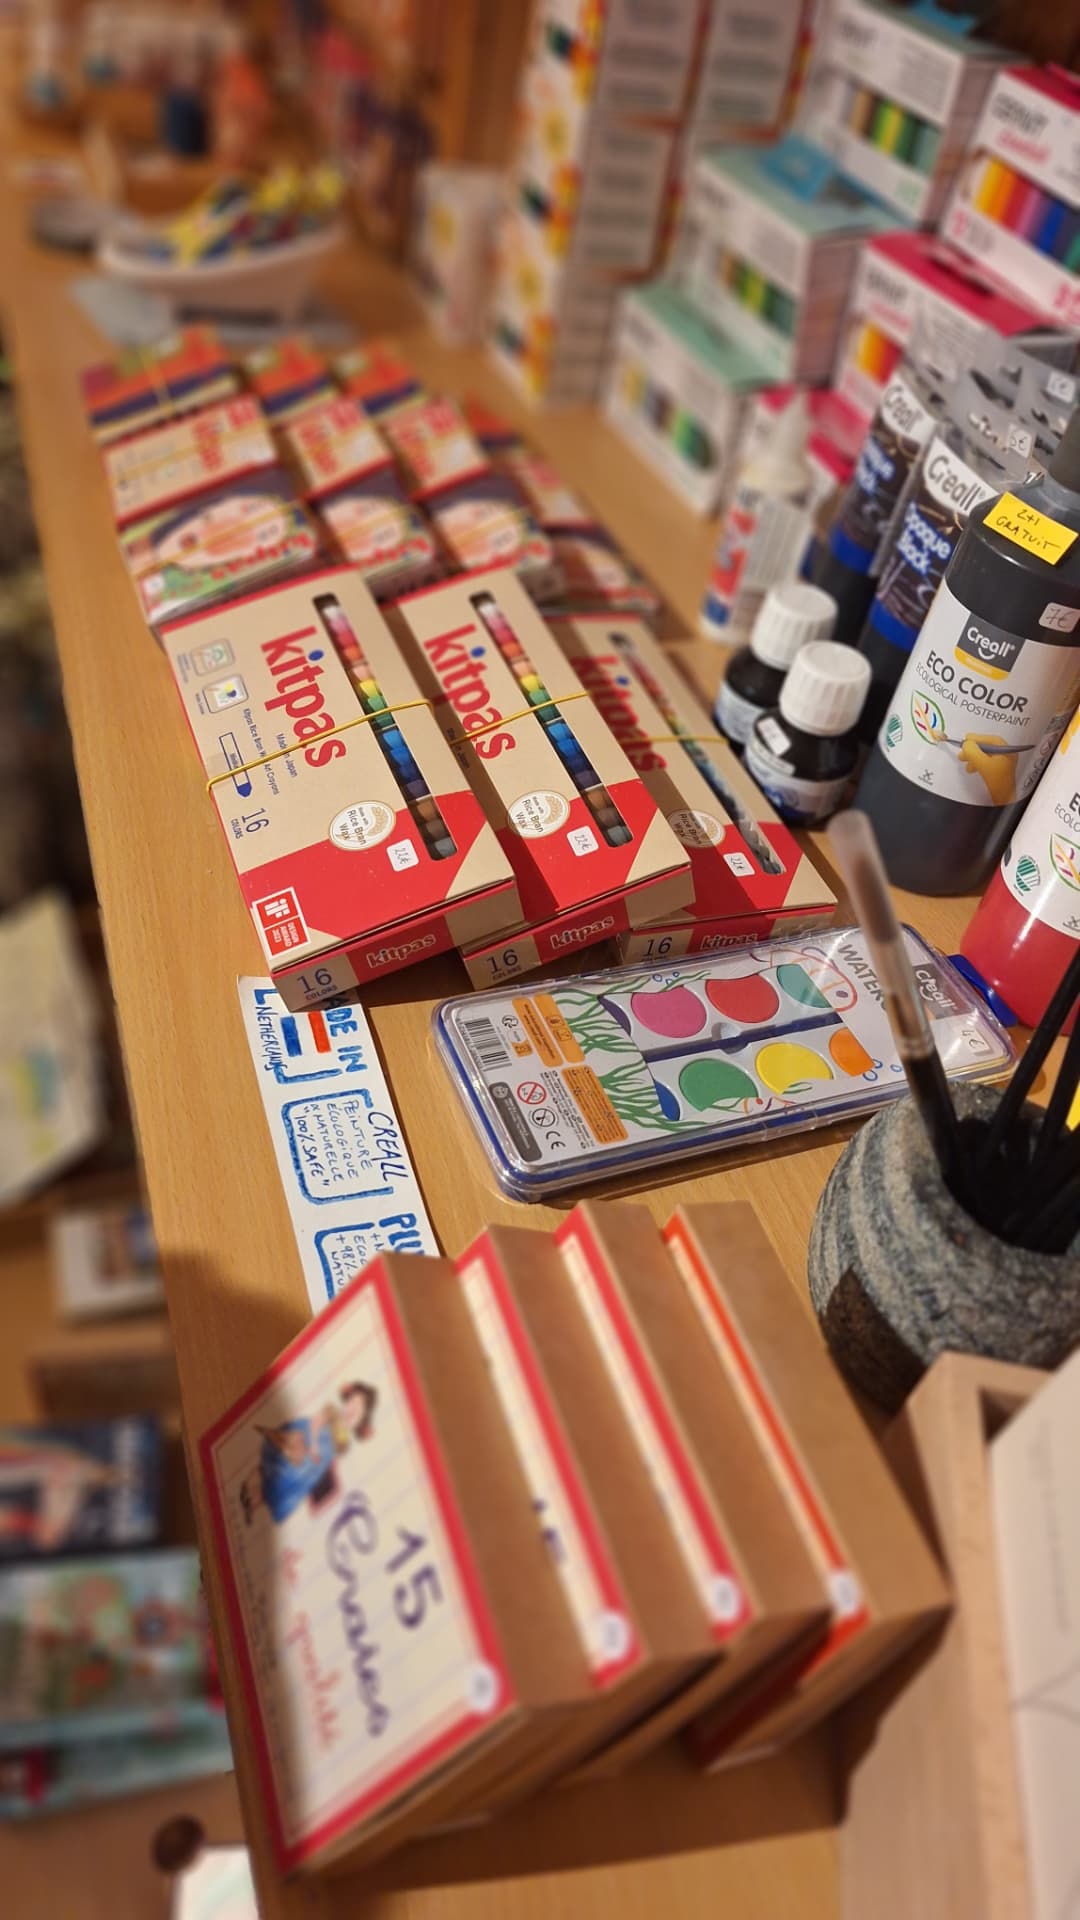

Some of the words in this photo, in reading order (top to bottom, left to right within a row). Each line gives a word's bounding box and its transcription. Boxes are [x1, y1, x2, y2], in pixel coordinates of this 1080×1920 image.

[928, 455, 981, 512] Creall
[1016, 508, 1041, 527] 2+1
[1045, 608, 1074, 629] 7€
[966, 626, 1010, 658] Creall
[261, 625, 347, 768] kitpas
[423, 623, 516, 760] kitpas
[915, 664, 958, 706] ECOLOGICAL
[960, 699, 1032, 727] POSTERPAINT
[926, 651, 955, 683] ECO
[957, 677, 1029, 713] COLOR
[231, 819, 243, 839] COLORS
[241, 807, 270, 832] 16
[347, 809, 359, 827] Rice
[354, 826, 367, 845] Bran
[531, 815, 544, 832] Bran
[550, 915, 615, 950] kitpas
[643, 936, 672, 957] 16
[700, 933, 759, 950] kitpas
[366, 934, 436, 968] kitpas
[486, 949, 518, 973] 16
[297, 968, 332, 993] 16
[304, 985, 338, 1001] COLORS
[838, 944, 886, 1011] WATER
[914, 969, 955, 1009] Creall
[326, 994, 359, 1038] ADE
[337, 1045, 368, 1073] IN
[313, 1113, 345, 1182] NATURELLE
[367, 1111, 409, 1182] CREALL
[331, 1251, 346, 1287] NATU
[385, 1525, 444, 1630] 15
